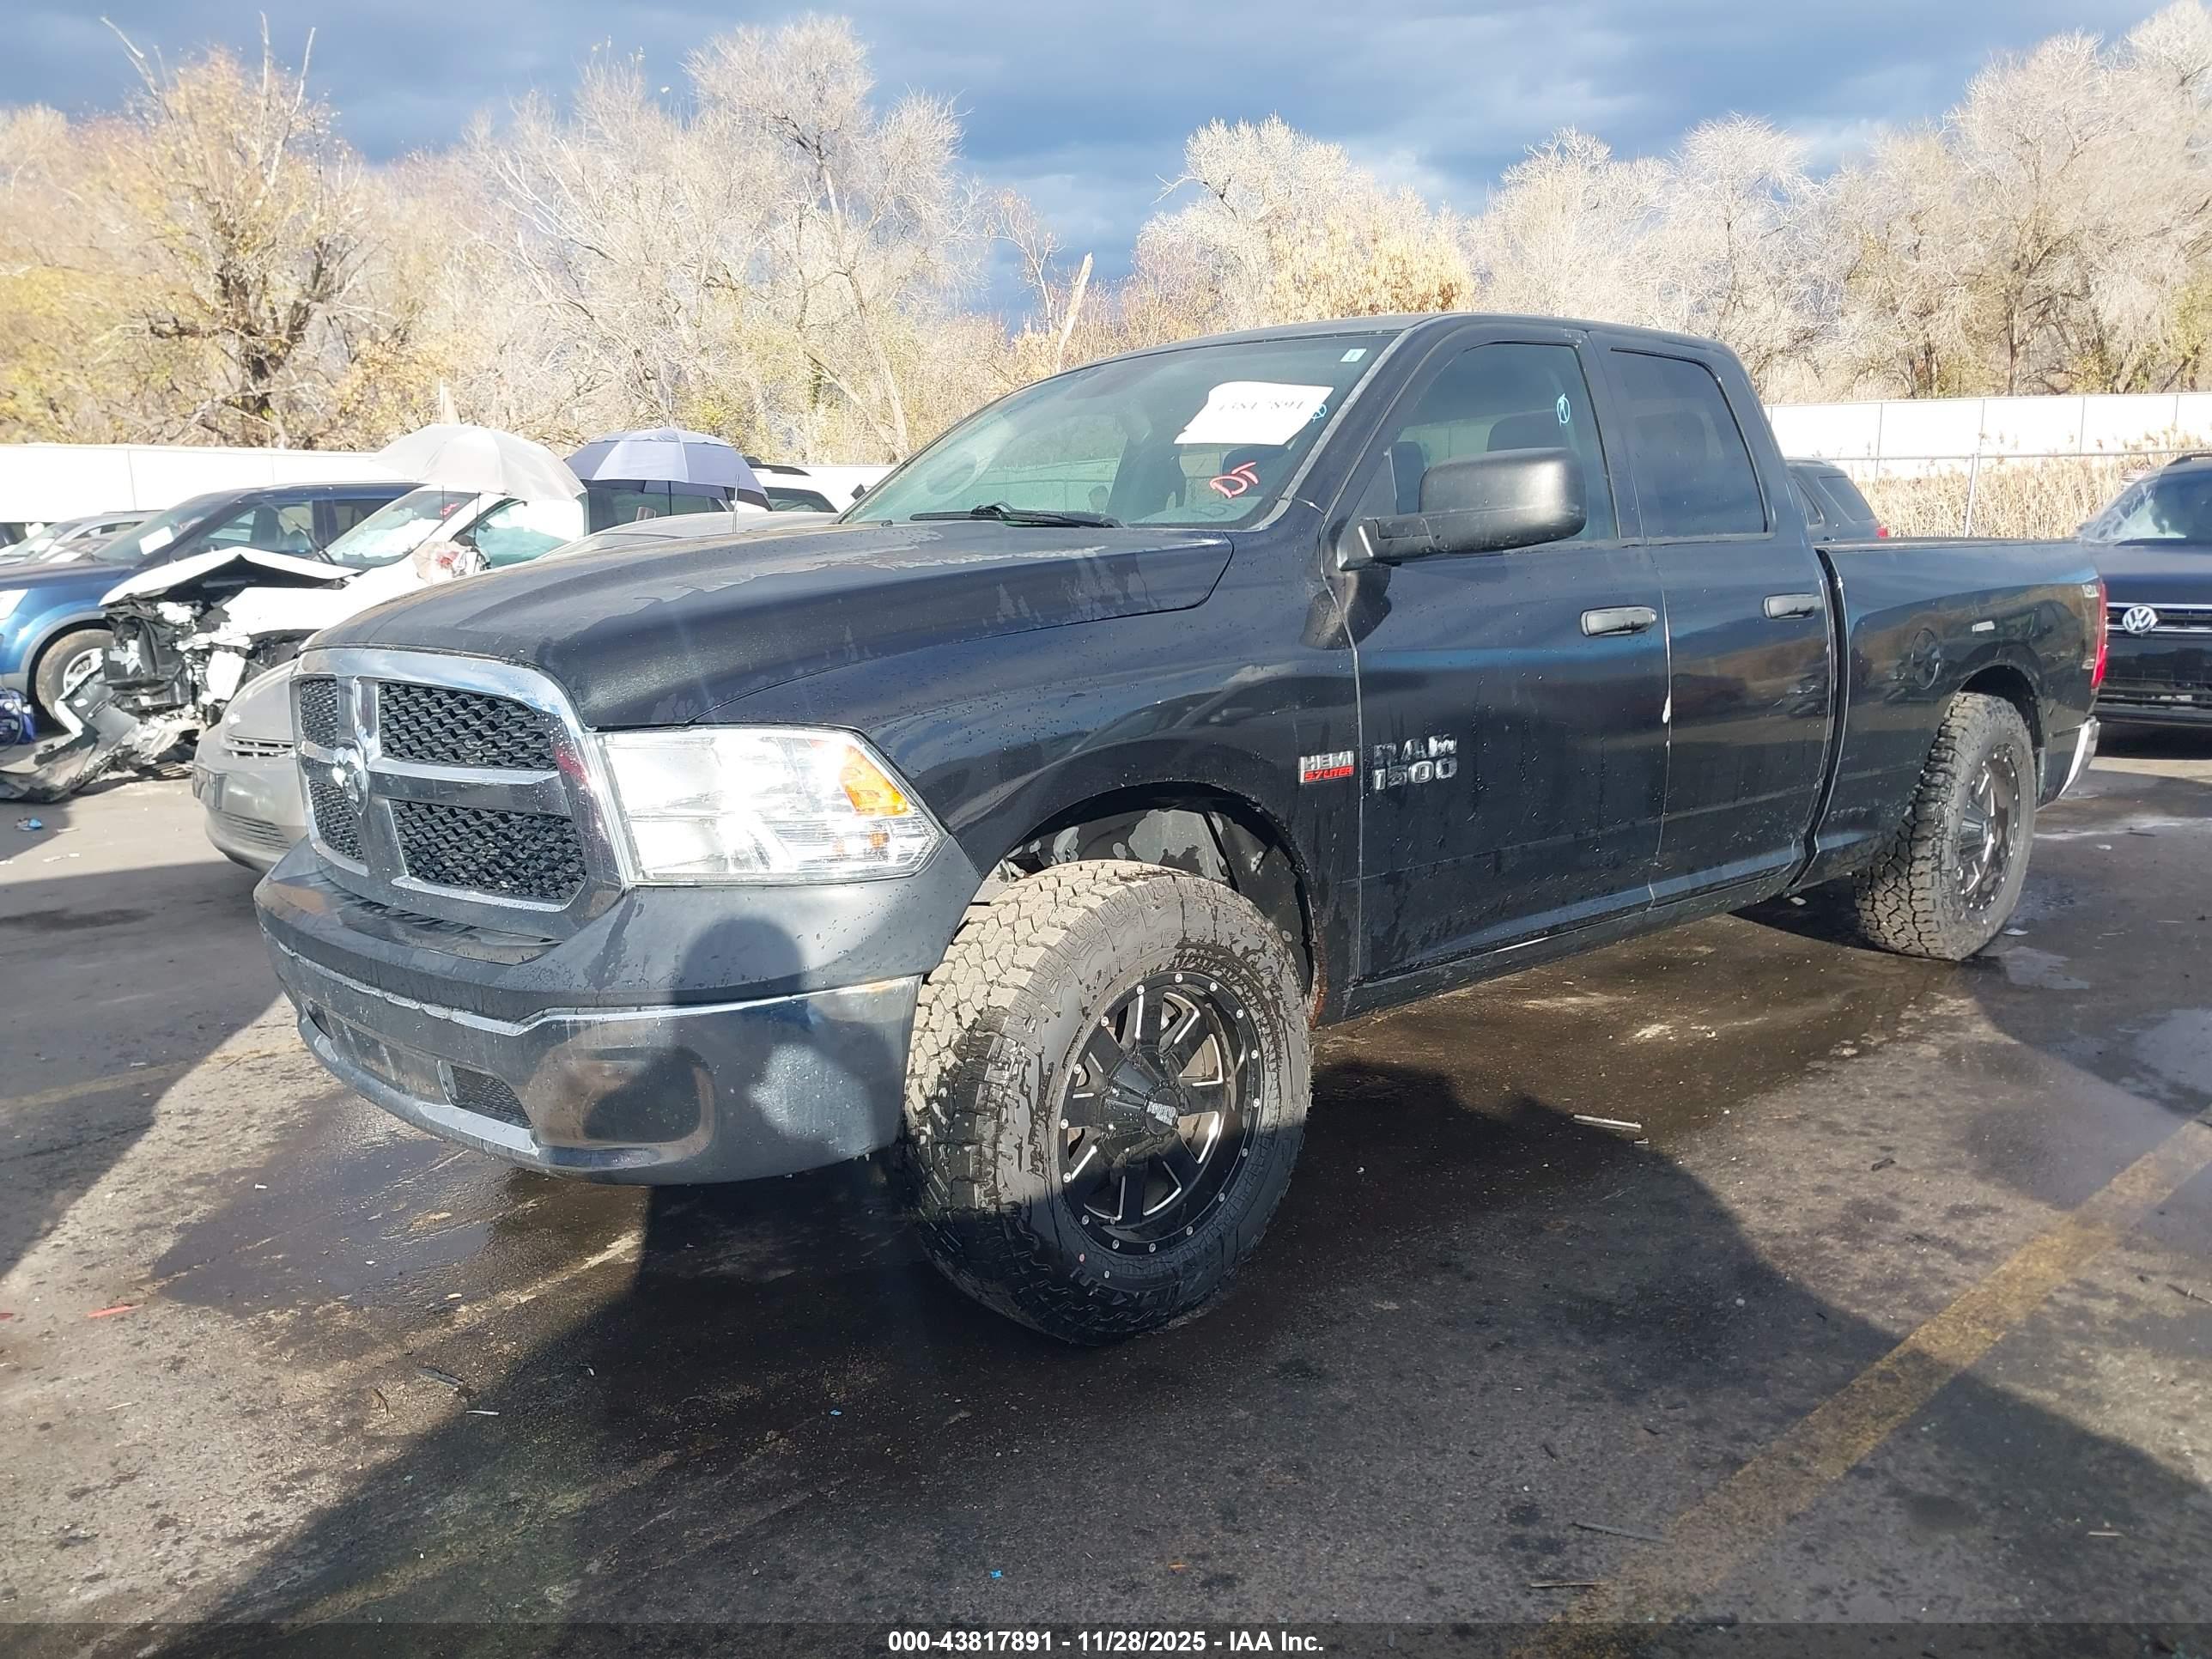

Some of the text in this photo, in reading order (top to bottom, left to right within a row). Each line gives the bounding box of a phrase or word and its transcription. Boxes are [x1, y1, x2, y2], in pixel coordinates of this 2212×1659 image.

[1300, 750, 1354, 771] HEMI
[1374, 735, 1457, 767] RAM
[1323, 765, 1352, 779] LITER
[1374, 757, 1458, 790] 1500
